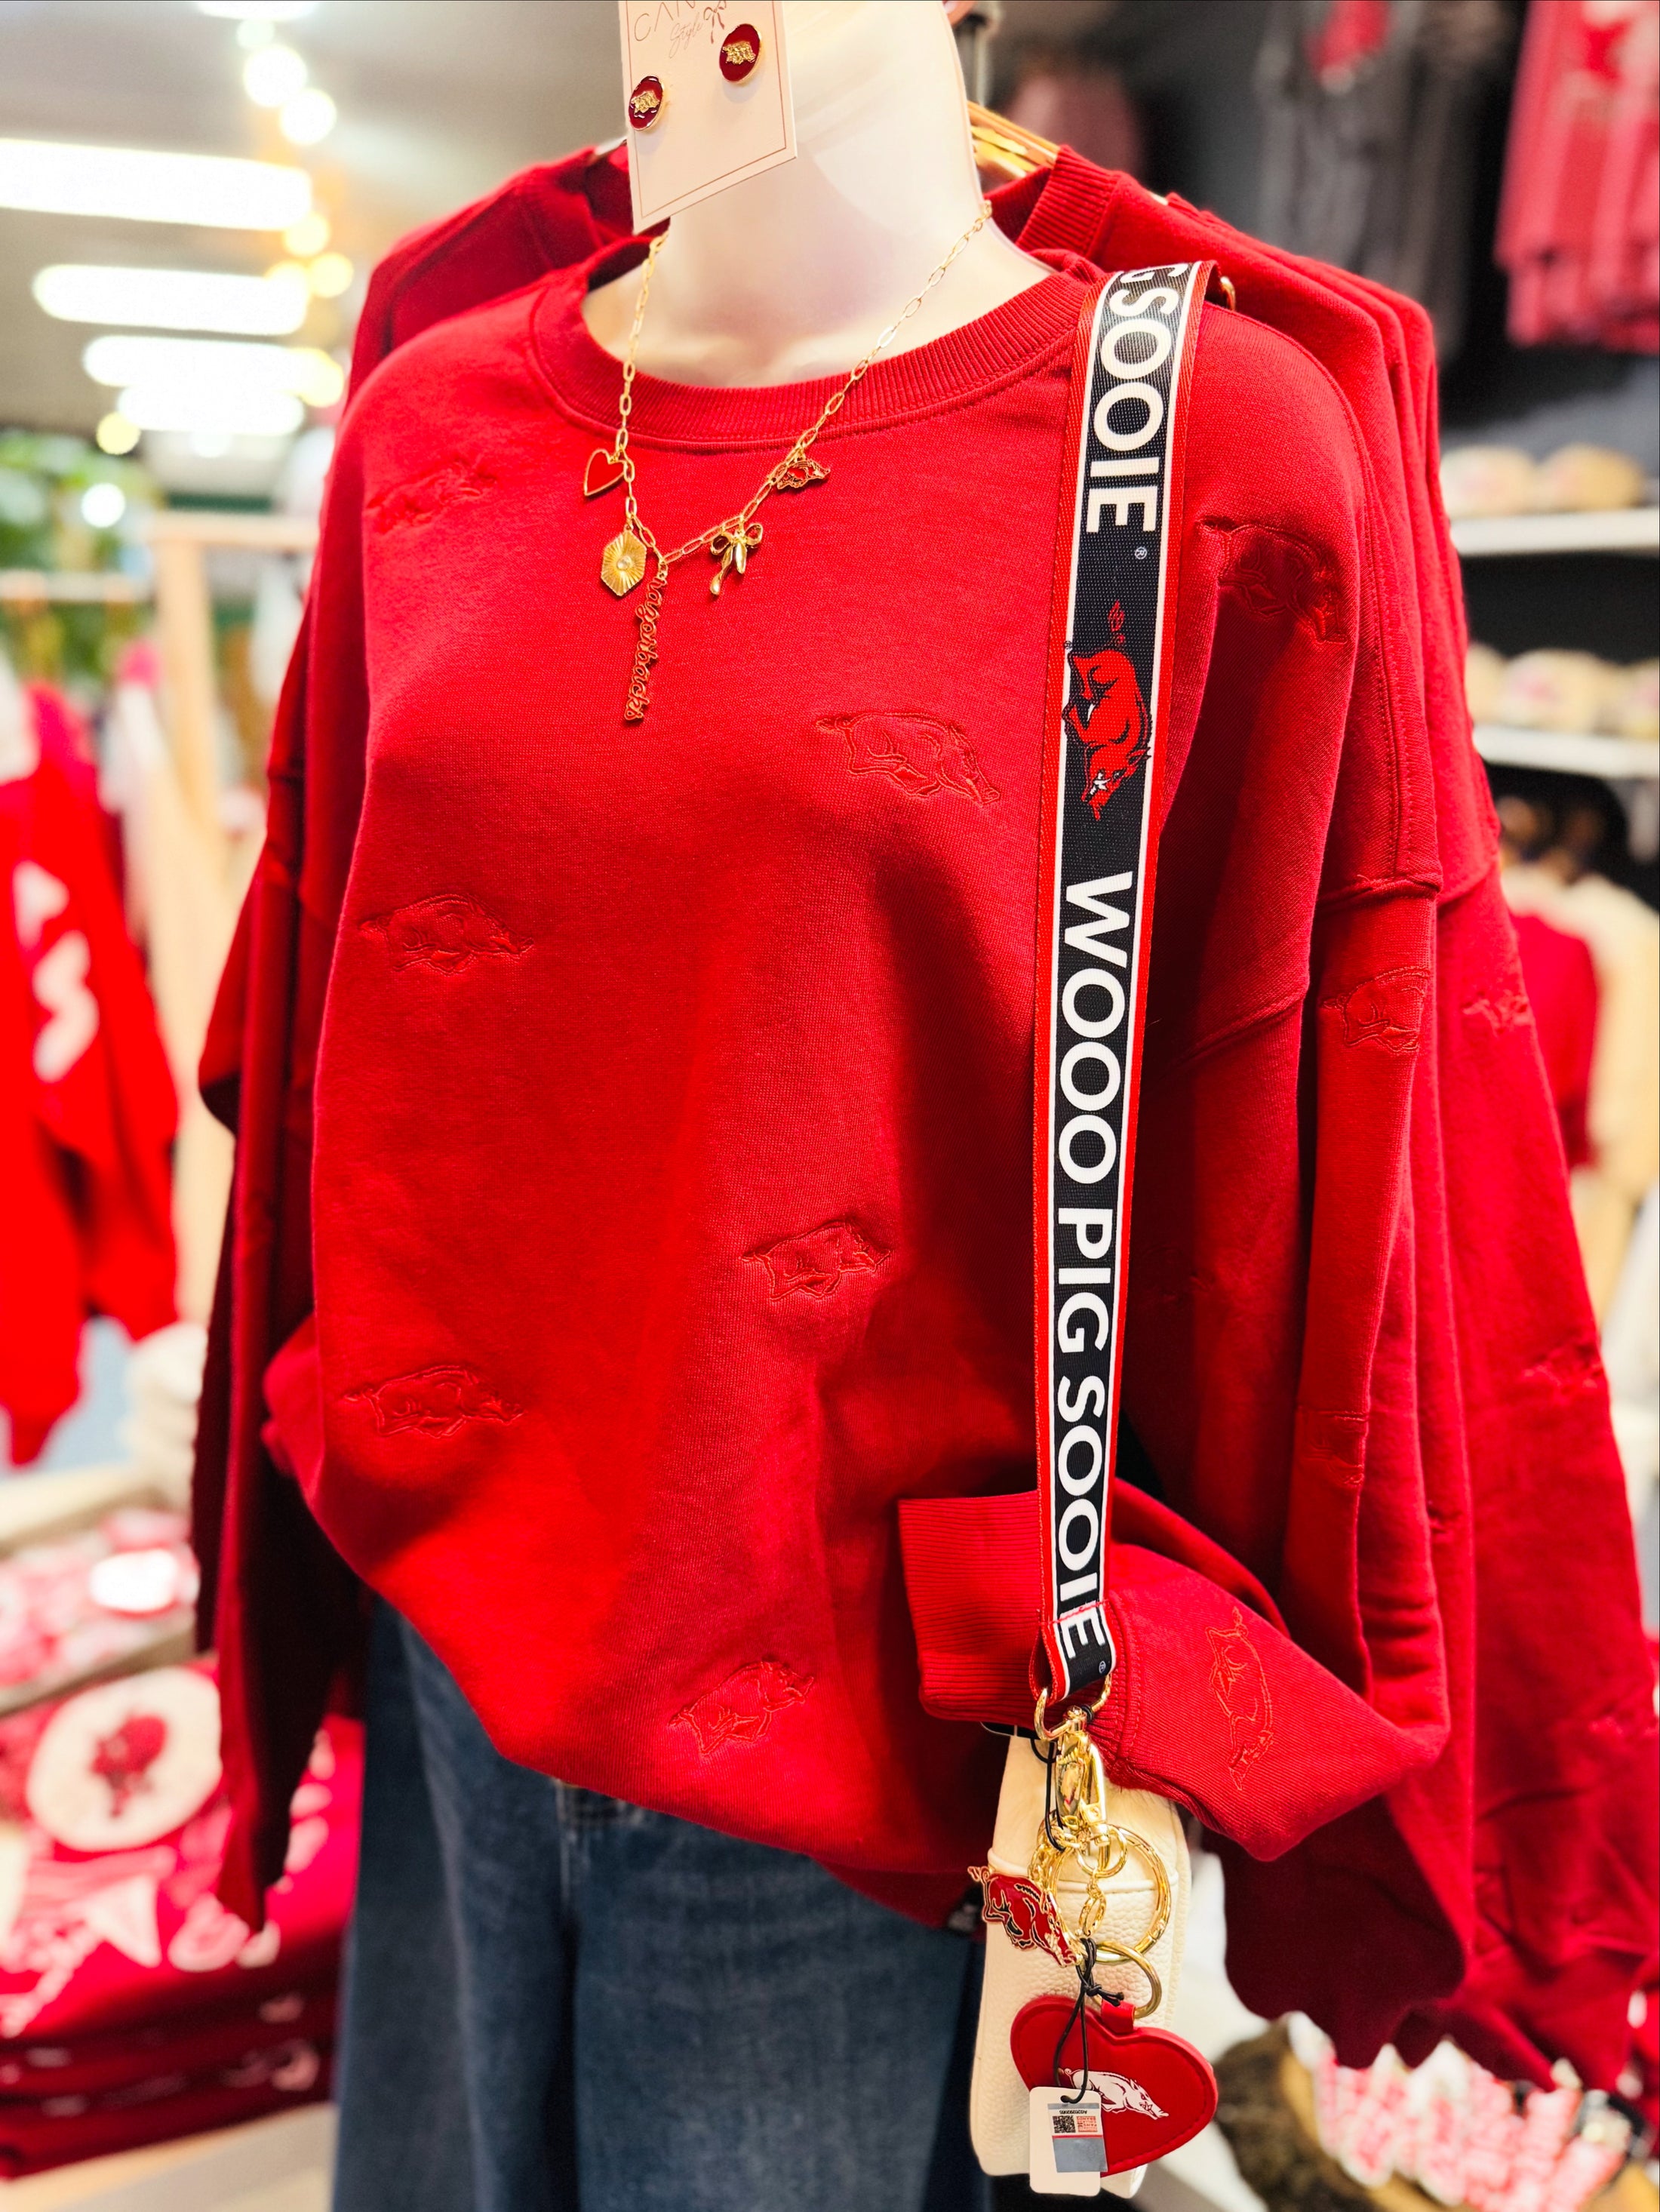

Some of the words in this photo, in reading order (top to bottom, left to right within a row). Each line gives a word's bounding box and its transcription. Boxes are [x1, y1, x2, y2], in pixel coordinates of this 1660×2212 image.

[1086, 287, 1179, 533] SOOIE
[624, 577, 667, 721] razorbacks
[1059, 871, 1133, 1184] WOOO
[1058, 1208, 1113, 1354] PIG
[1058, 1375, 1106, 1659] SOOIE
